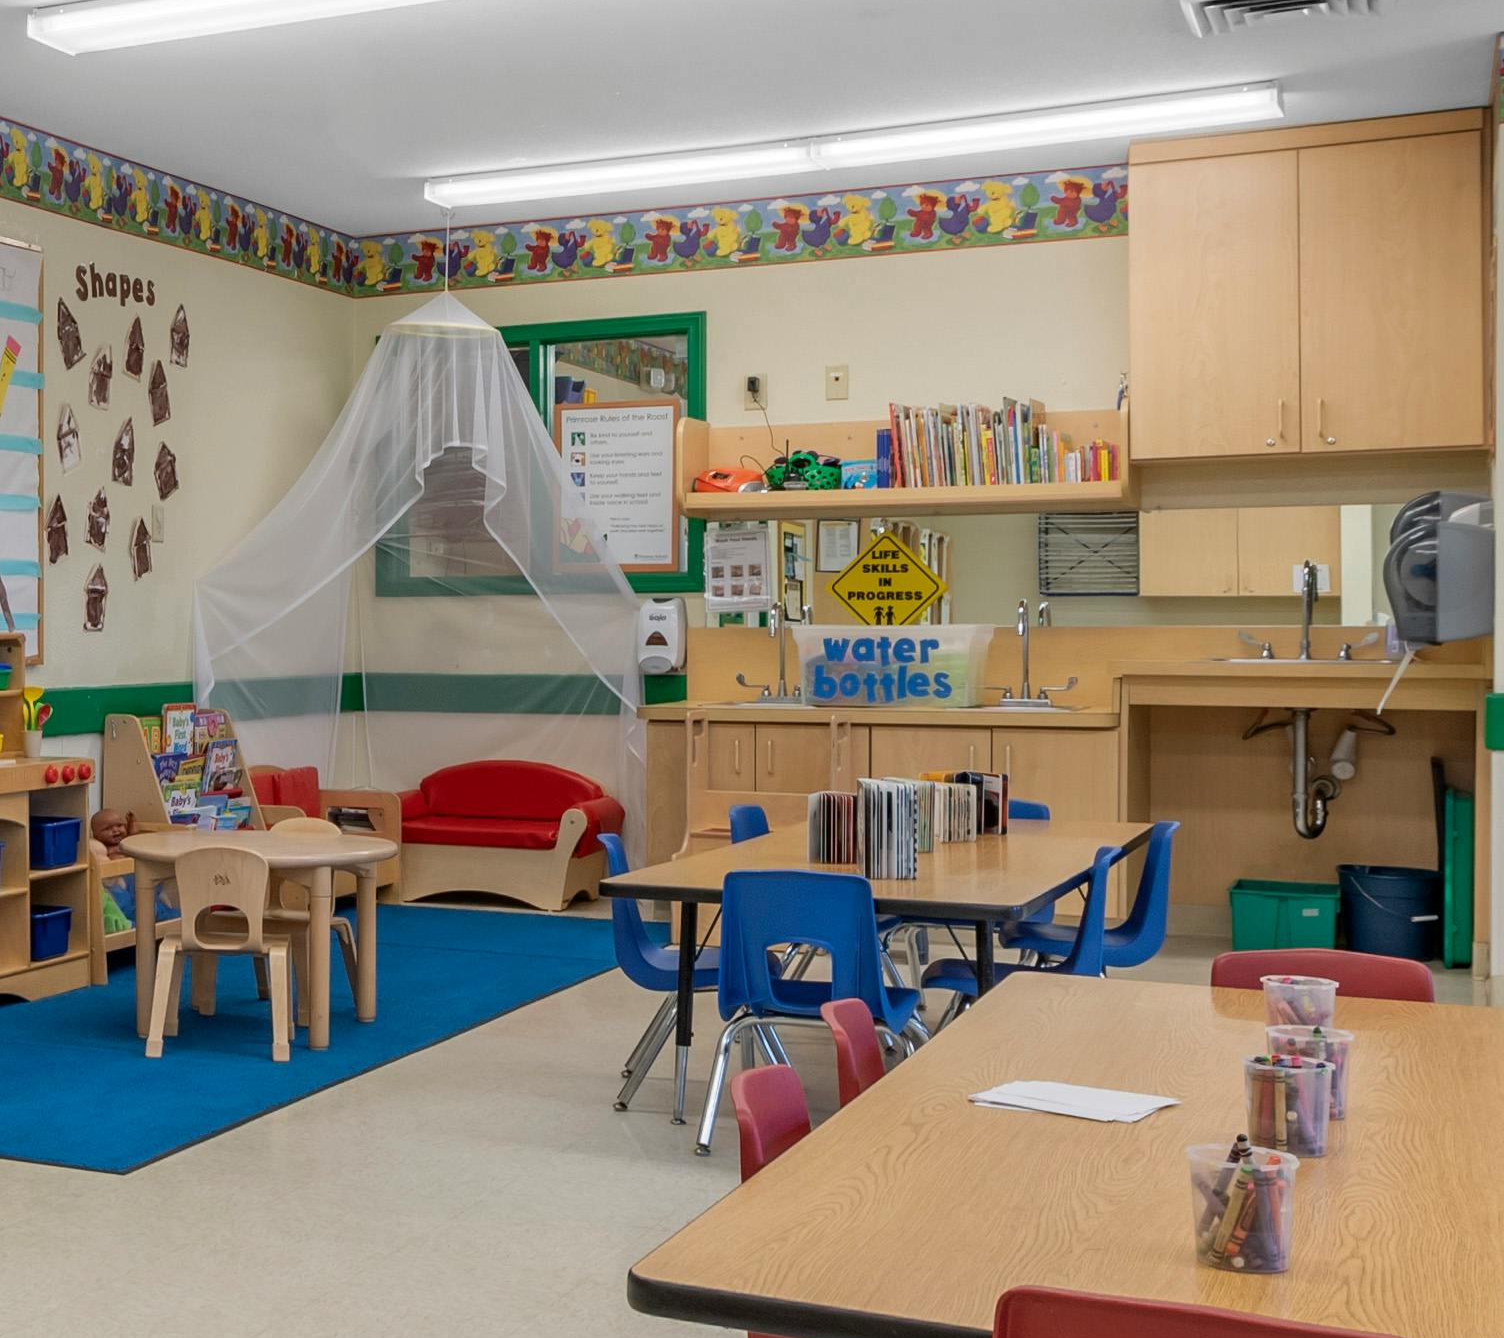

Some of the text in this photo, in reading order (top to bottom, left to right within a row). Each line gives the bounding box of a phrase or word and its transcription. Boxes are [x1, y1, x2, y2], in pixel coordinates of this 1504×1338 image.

[75, 261, 156, 307] Shapes
[599, 414, 620, 422] Rules
[871, 549, 900, 560] LIFE
[861, 563, 910, 574] SKILLS
[878, 577, 892, 587] IN
[847, 591, 923, 601] PROGRESS
[823, 635, 940, 667] water
[813, 664, 953, 704] bottles
[171, 795, 192, 807] Baby's
